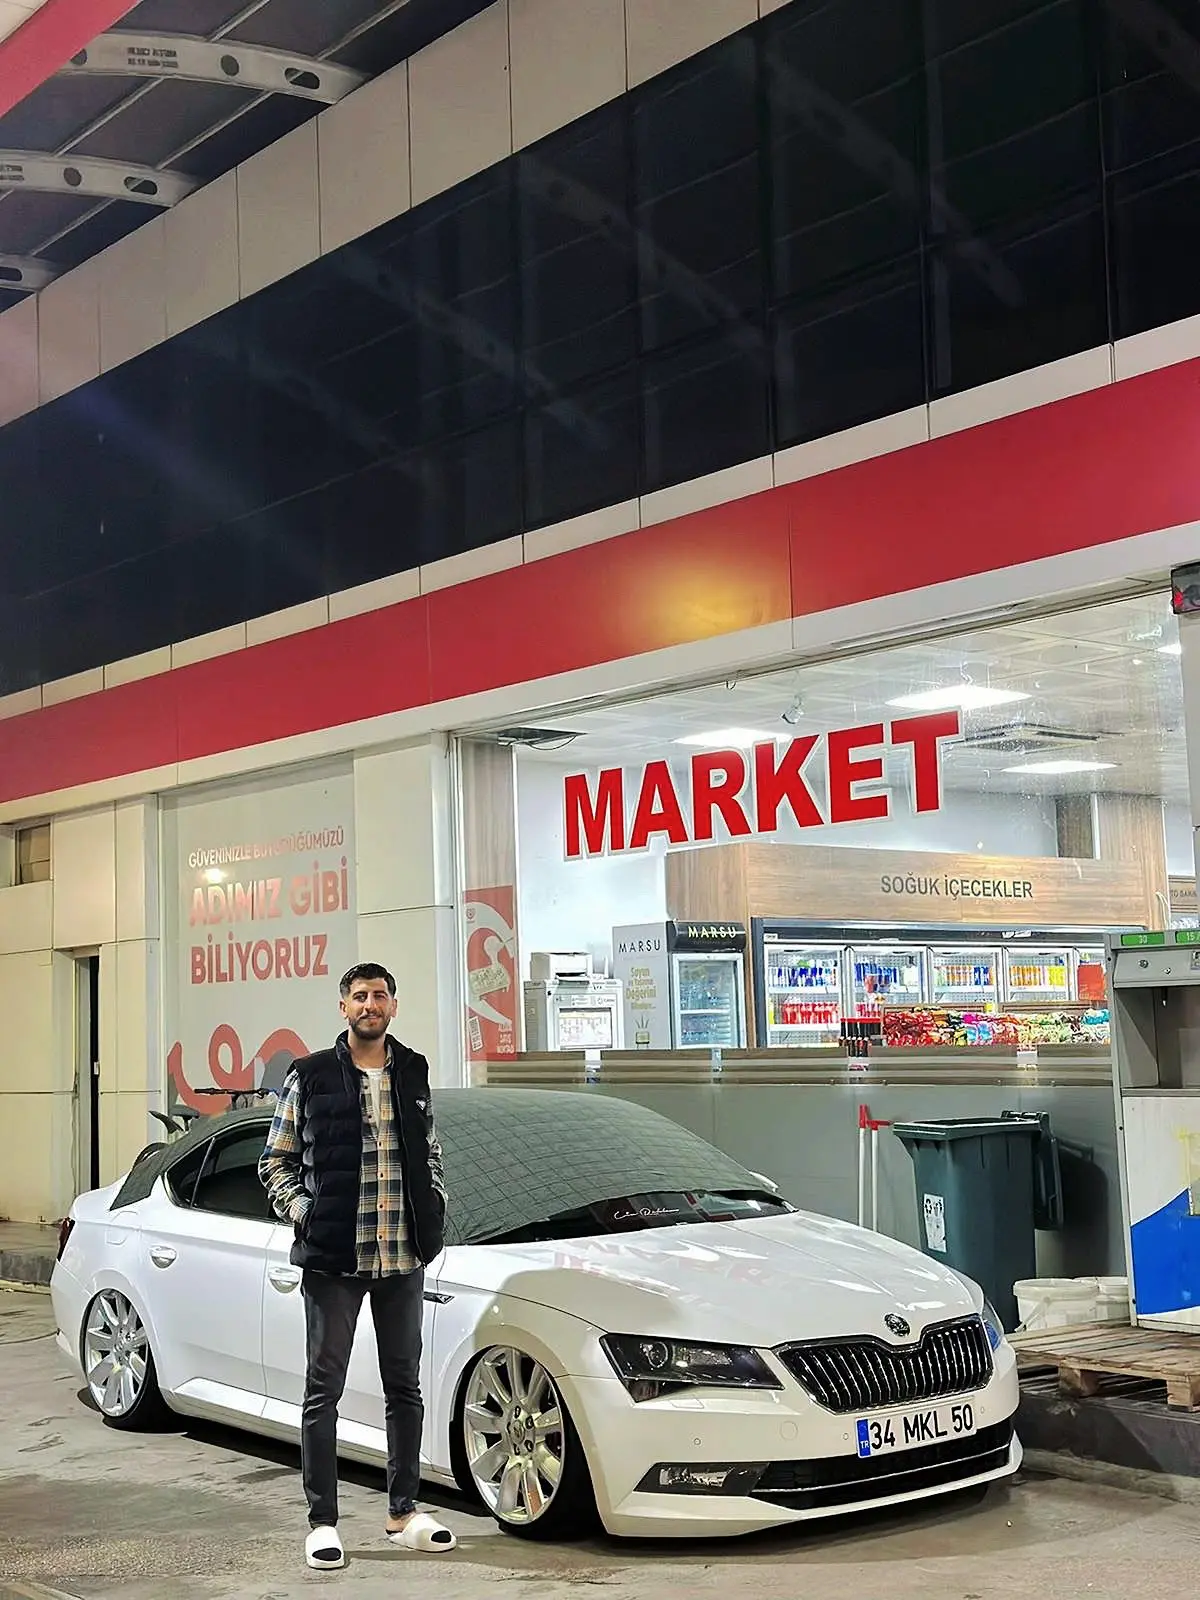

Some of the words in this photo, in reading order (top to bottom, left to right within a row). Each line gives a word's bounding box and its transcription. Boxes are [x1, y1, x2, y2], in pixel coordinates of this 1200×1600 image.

[563, 708, 961, 859] MARKET
[190, 877, 283, 927] ADIMIZ
[289, 855, 348, 916] GİBİ
[880, 872, 940, 896] SOĞUK
[944, 874, 1033, 900] İÇECEKLER
[618, 939, 661, 953] MARSU
[688, 925, 737, 939] MARSU
[191, 931, 329, 984] BİLİYORUZ
[859, 1440, 870, 1449] TR
[869, 1419, 896, 1449] 34
[903, 1411, 948, 1444] MKL
[951, 1403, 974, 1433] 50
